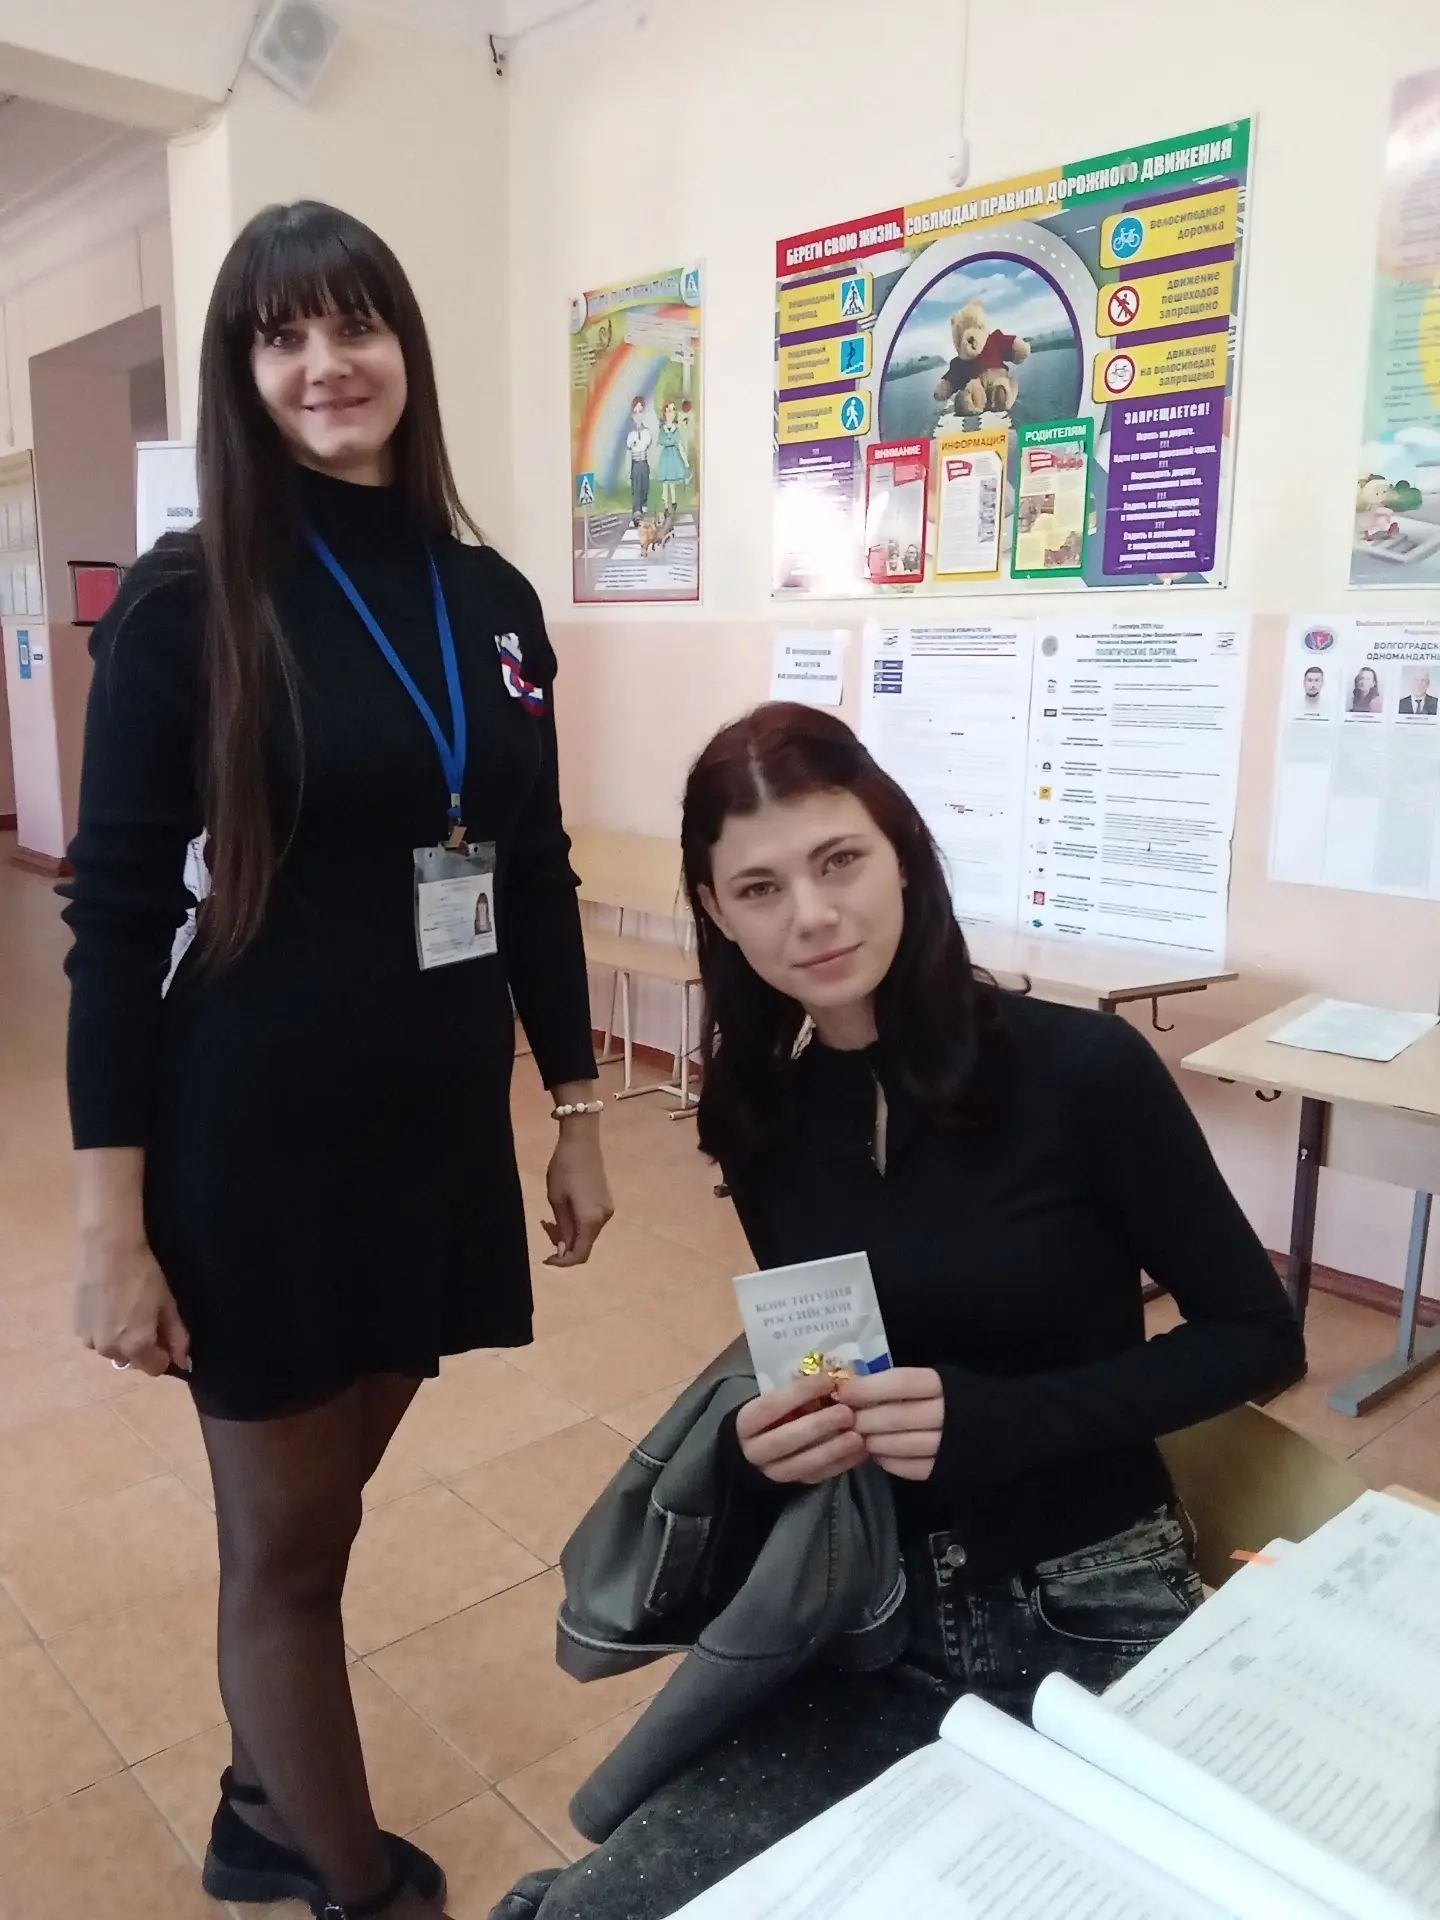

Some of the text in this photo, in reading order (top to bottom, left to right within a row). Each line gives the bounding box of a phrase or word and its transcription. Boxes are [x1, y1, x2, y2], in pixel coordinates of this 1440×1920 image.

[786, 241, 823, 266] БЕРЕГИ
[824, 232, 858, 257] СВОЮ
[905, 200, 978, 236] СОБЛЮДАЙ
[981, 186, 1044, 218] ПРАВИЛА
[1046, 162, 1138, 205] ДОРОЖНОГО
[1141, 138, 1233, 182] ДВИЖЕНИЯ
[1178, 221, 1225, 240] дорожка
[1167, 271, 1220, 290] движение
[1161, 286, 1219, 305] пешеходов
[1166, 344, 1217, 361] движение
[1140, 367, 1152, 376] на
[1124, 402, 1211, 425] ЗАПРЕЩАЕТСЯ!
[1025, 424, 1087, 442] РОДИТЕЛЯМ
[874, 444, 921, 460] ВНИМАНИЕ
[941, 435, 1006, 451] ИНФОРМАЦИЯ
